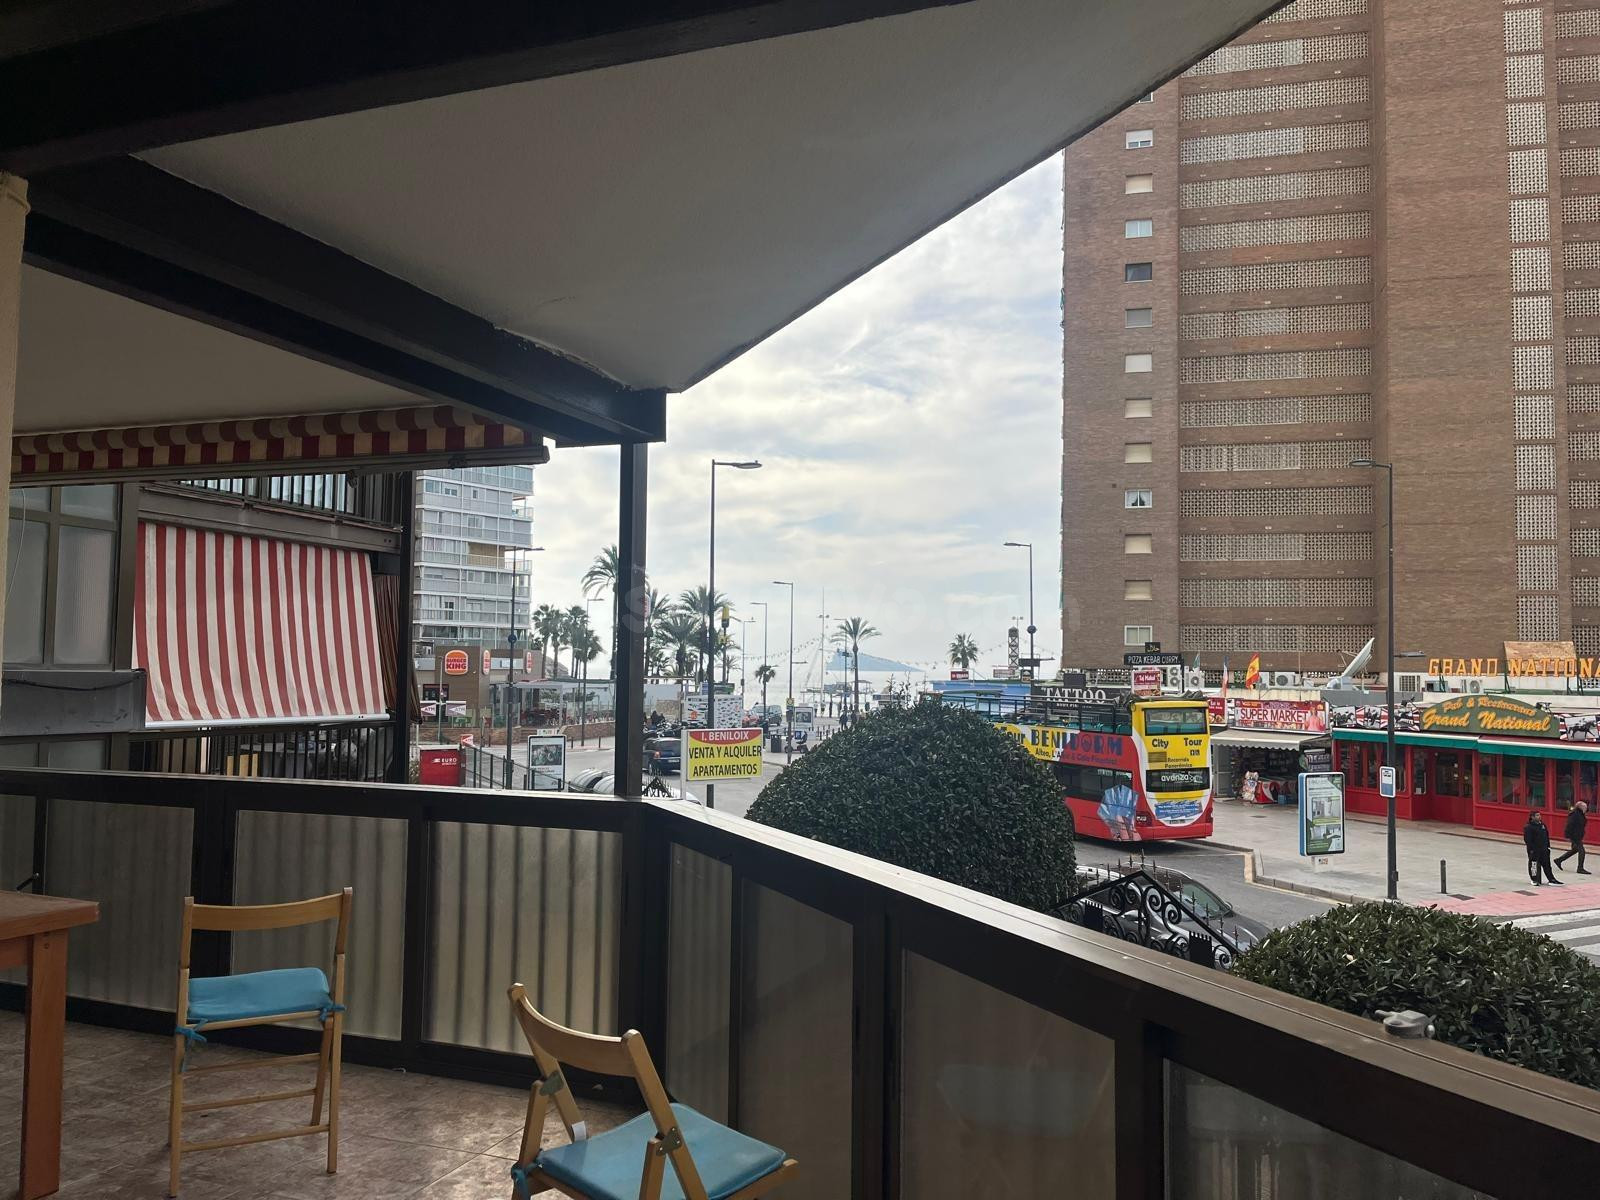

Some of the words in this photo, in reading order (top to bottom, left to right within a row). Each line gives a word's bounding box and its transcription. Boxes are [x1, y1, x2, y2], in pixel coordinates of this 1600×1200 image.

[1127, 655, 1142, 664] PIZZA
[1143, 655, 1160, 664] KEBAB
[1428, 658, 1498, 676] GRAND
[1041, 687, 1106, 704] TATTOO
[1466, 697, 1474, 708] &
[1240, 708, 1268, 721] SUPER
[1270, 709, 1309, 722] MARKET
[1421, 709, 1470, 730] Grand
[1477, 711, 1551, 731] National
[708, 731, 749, 741] BENILOIX
[1151, 738, 1169, 749] City
[1183, 737, 1203, 746] Tour
[689, 746, 715, 759] VENTA
[716, 746, 722, 757] Y
[723, 745, 762, 758] ALQUILER
[693, 763, 758, 777] APARTAMENTOS
[1160, 773, 1189, 782] avanza
